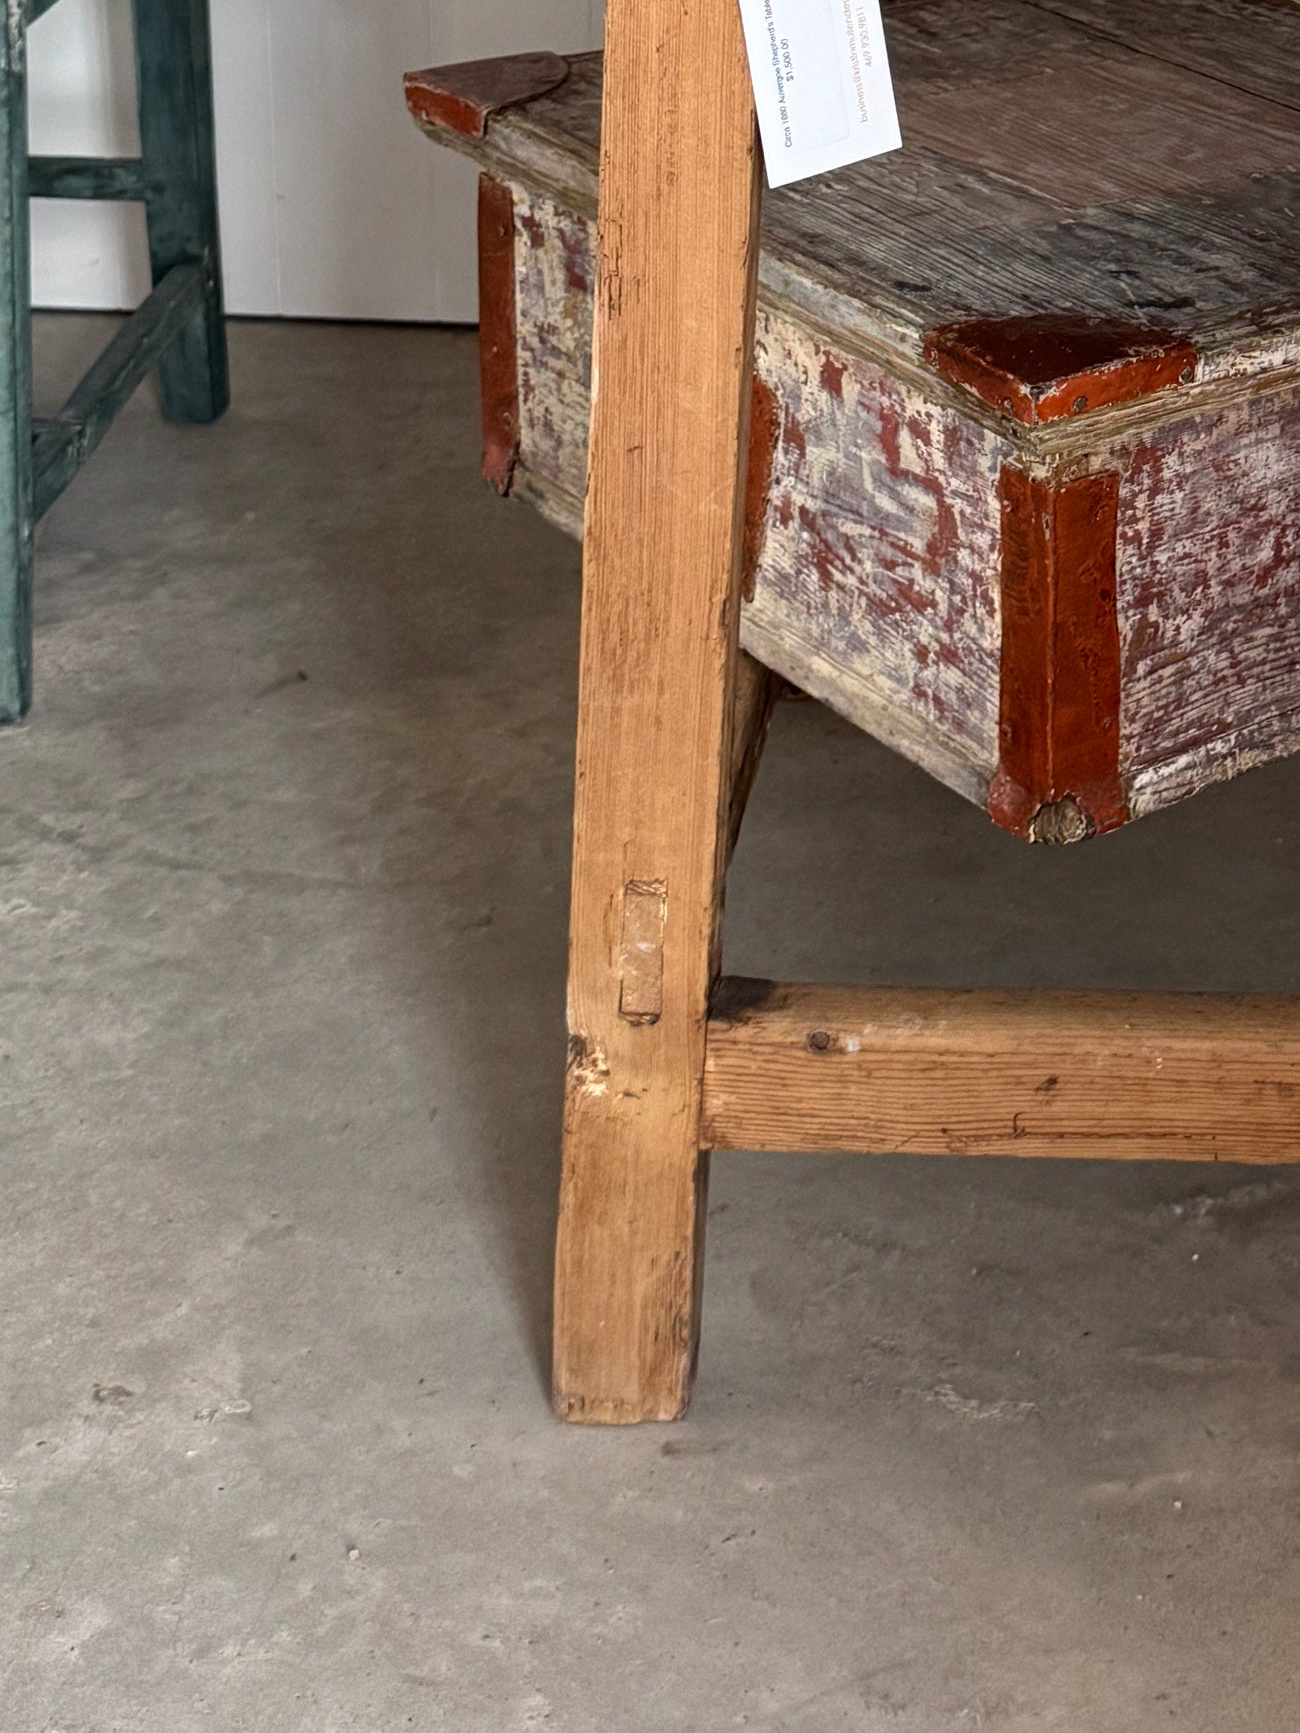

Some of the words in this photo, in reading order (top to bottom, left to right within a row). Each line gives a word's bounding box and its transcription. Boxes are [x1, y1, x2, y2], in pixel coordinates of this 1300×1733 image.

[764, 0, 773, 21] Table
[767, 21, 780, 66] Shepherd's
[775, 67, 786, 103] Auvergne
[784, 126, 793, 147] Circa
